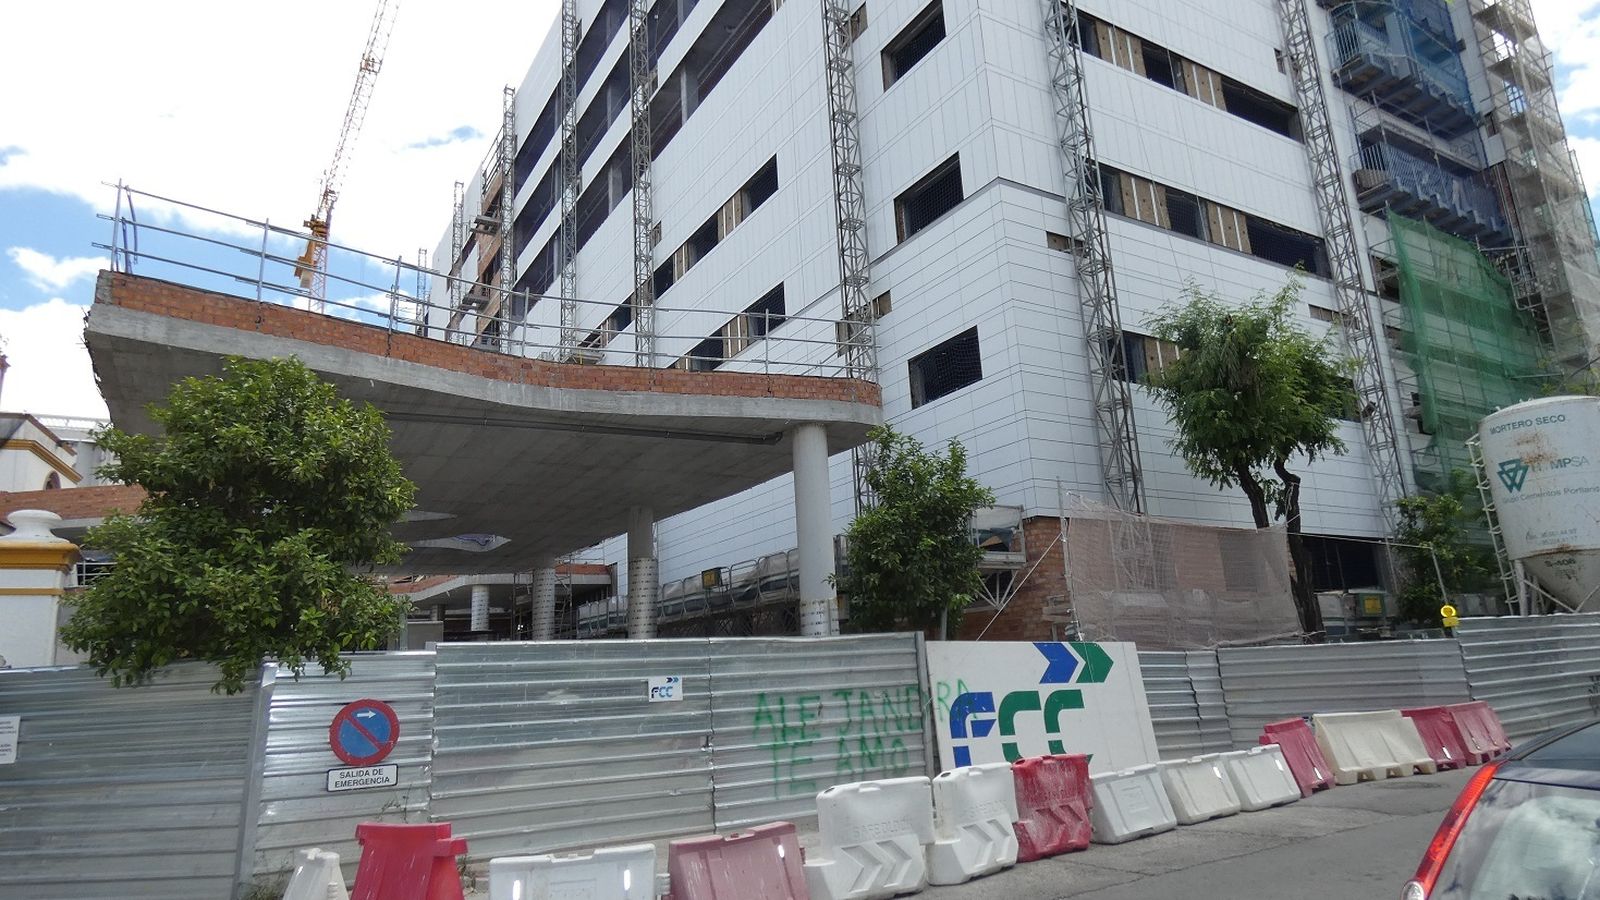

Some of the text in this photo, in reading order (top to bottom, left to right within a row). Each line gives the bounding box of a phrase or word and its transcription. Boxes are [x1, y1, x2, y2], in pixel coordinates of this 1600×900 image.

[1490, 414, 1566, 434] MORTERO SECO
[651, 686, 673, 698] FCC
[949, 689, 1093, 769] FCC
[835, 734, 910, 777] AMO
[339, 768, 384, 779] SALIDA DE
[334, 776, 390, 788] EMERGENCIA
